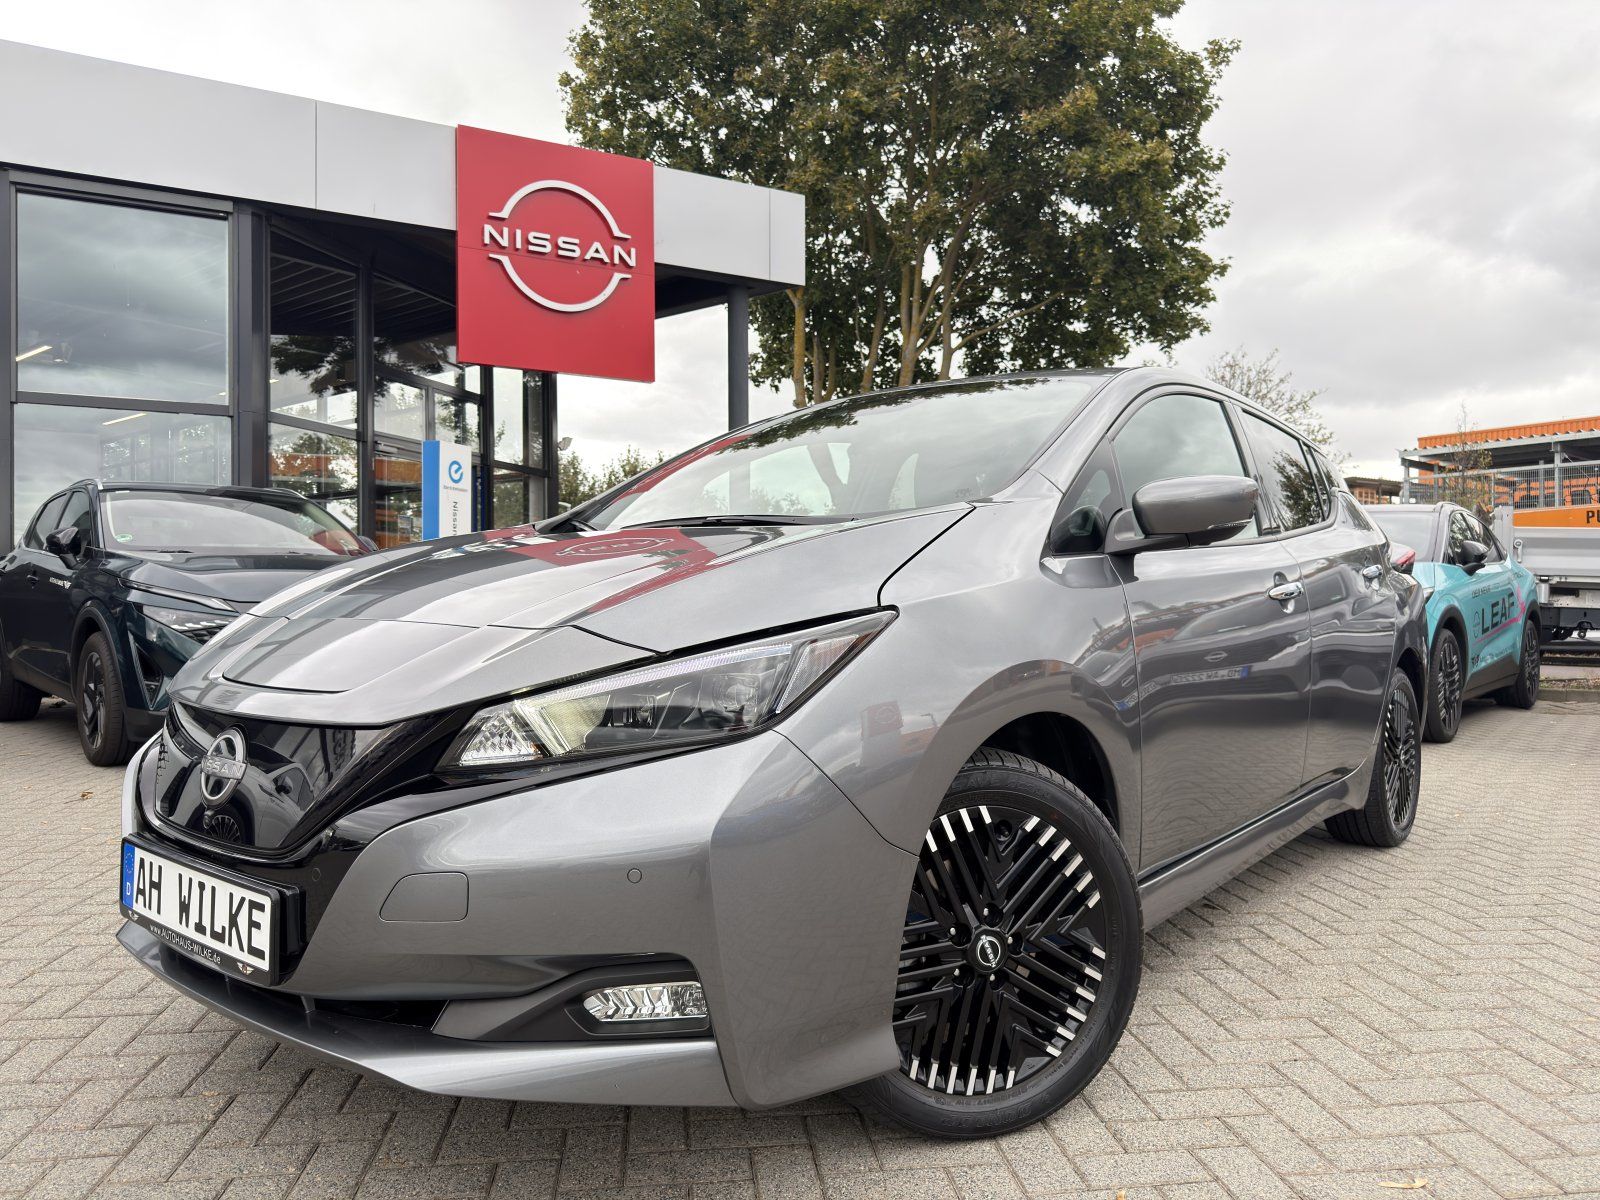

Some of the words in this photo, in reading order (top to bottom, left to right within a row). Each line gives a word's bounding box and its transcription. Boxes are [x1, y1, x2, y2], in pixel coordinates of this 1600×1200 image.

[483, 223, 636, 267] NISSAN
[1481, 592, 1514, 635] LEAF
[135, 857, 163, 915] AH
[178, 873, 266, 961] WILKE
